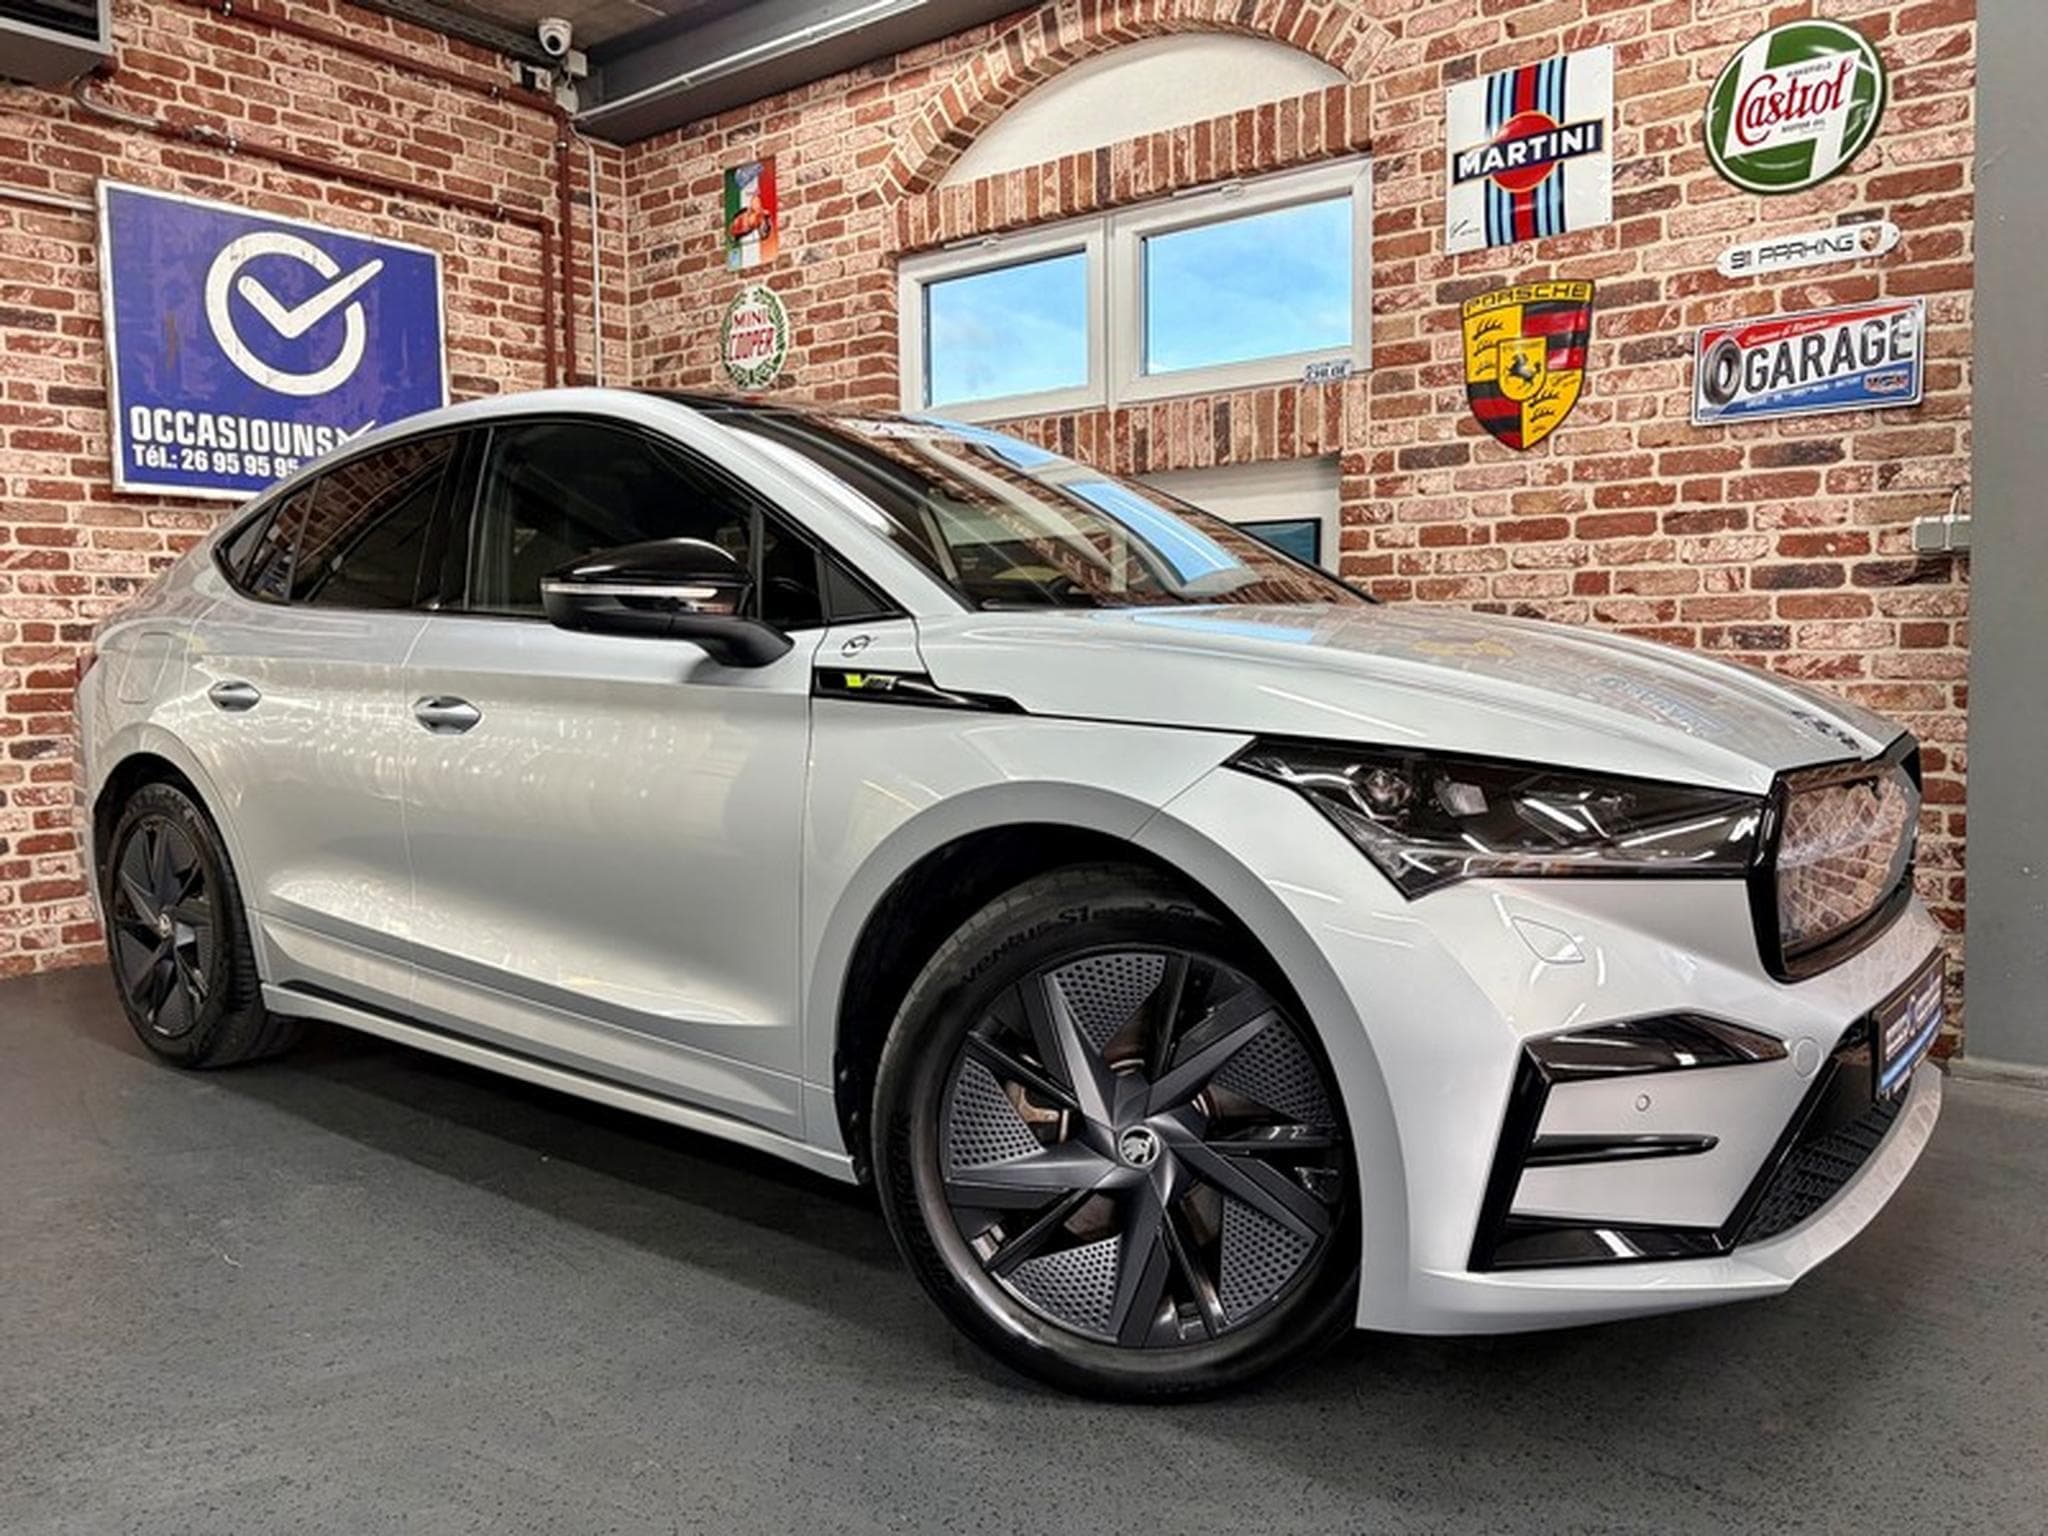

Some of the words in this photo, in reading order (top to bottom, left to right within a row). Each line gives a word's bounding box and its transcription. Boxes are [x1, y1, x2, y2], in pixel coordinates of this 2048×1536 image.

[1735, 57, 1855, 147] Castrol
[1458, 125, 1595, 179] MARTINI
[1758, 232, 1854, 264] PARKING
[1465, 282, 1589, 312] PORSCHE
[734, 311, 768, 327] MINI
[1744, 311, 1915, 394] GARAGE
[130, 405, 334, 458] OCCASIOUNS
[181, 448, 208, 472] 26
[212, 450, 240, 475] 95
[244, 453, 271, 477] 95
